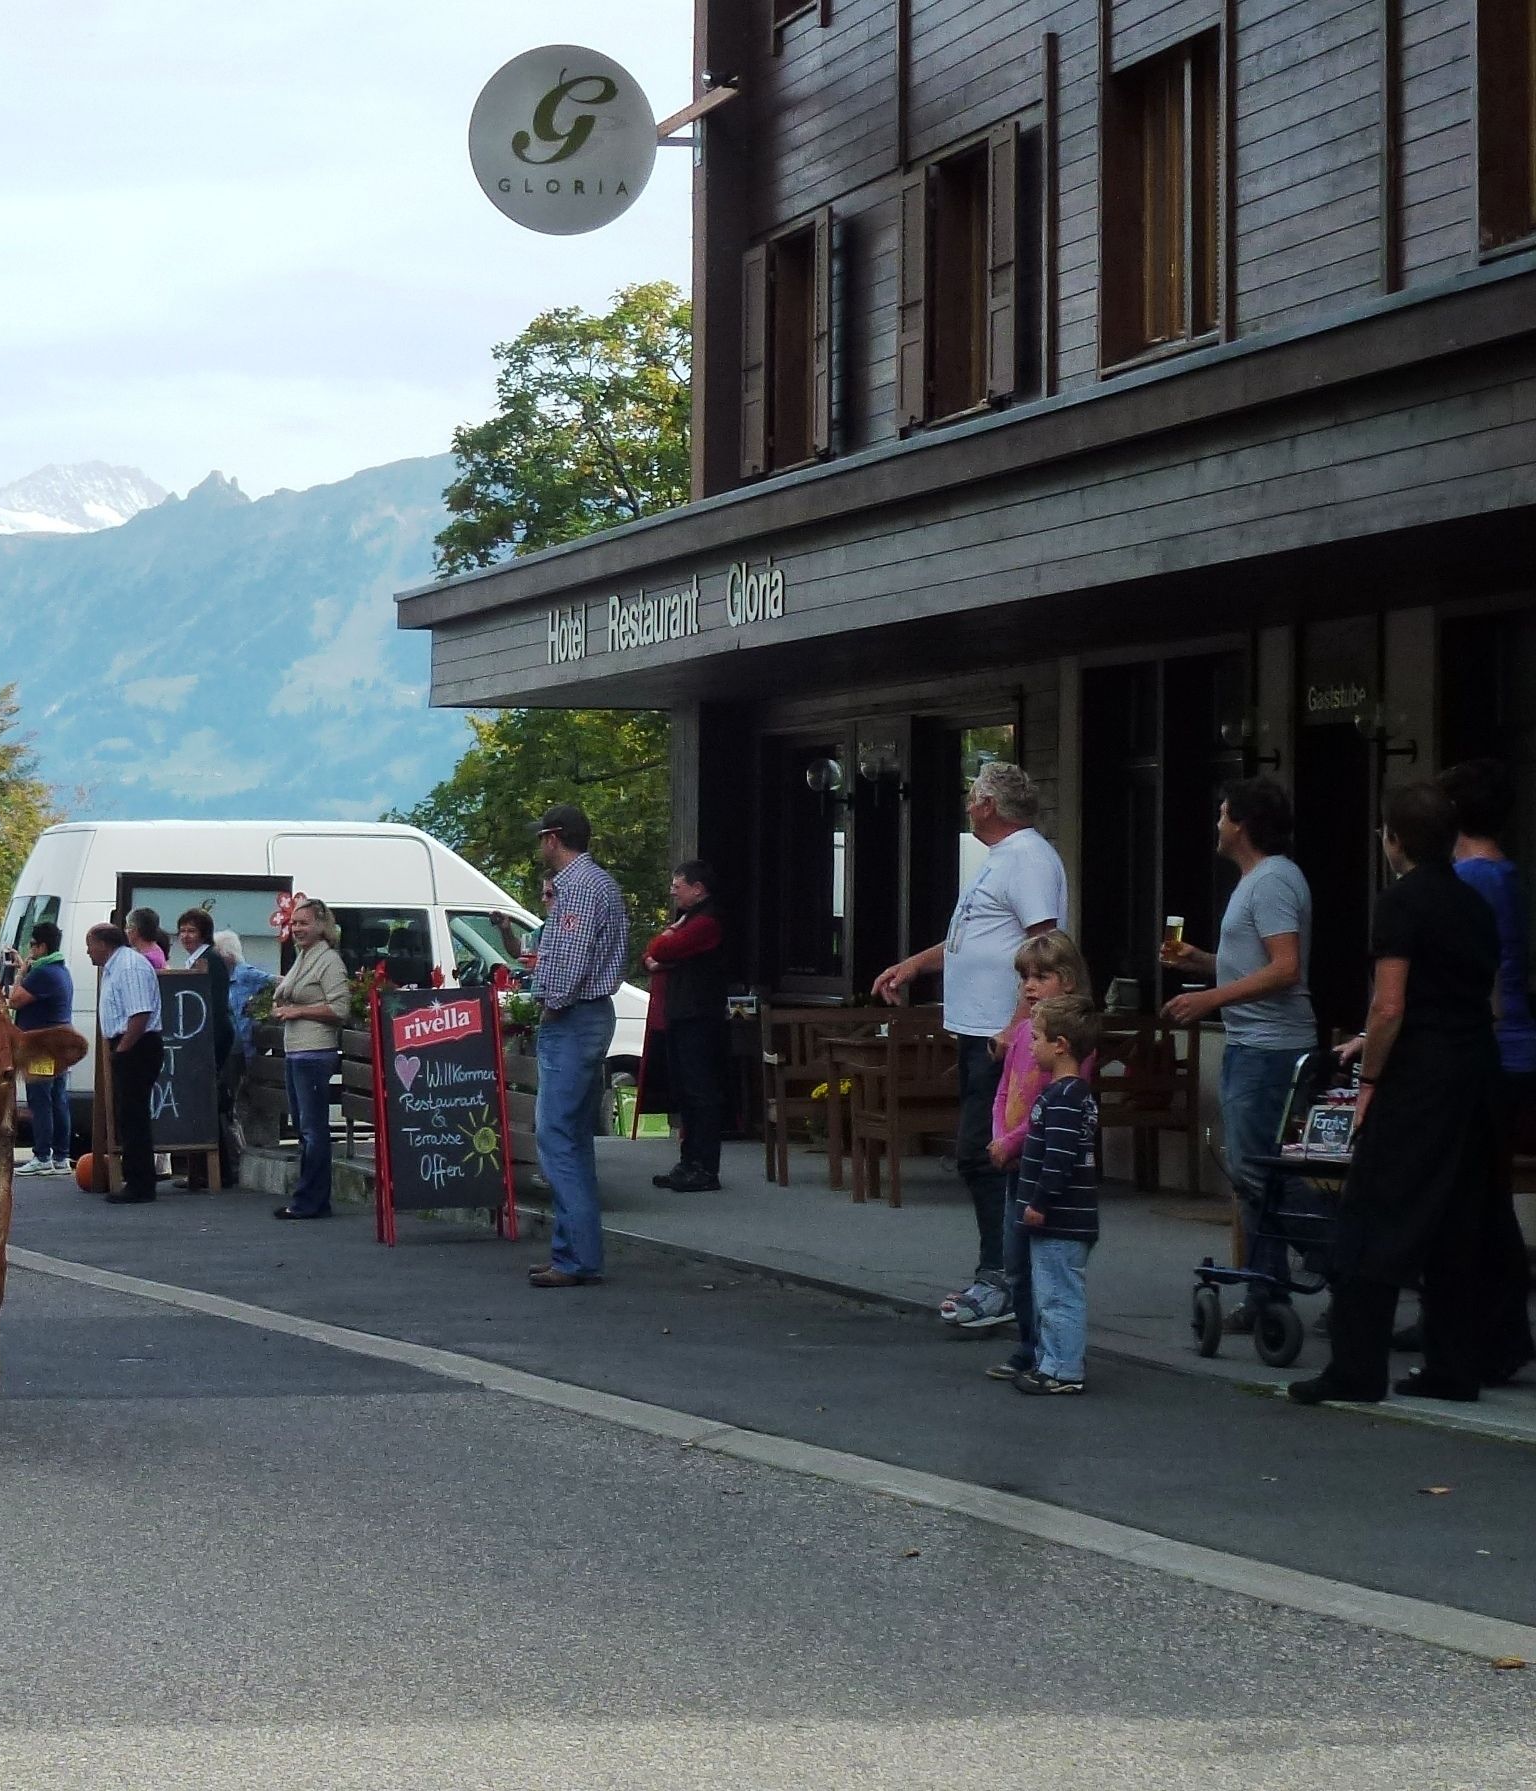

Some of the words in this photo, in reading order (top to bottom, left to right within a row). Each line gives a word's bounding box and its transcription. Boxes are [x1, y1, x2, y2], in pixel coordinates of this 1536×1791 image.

[498, 177, 630, 196] GLORIA
[547, 604, 588, 664] Hotel
[607, 573, 700, 652] Restaurant
[726, 555, 785, 628] Gloria
[1308, 682, 1366, 711] Gaststube
[404, 1008, 470, 1040] rivella
[399, 1092, 487, 1112] Restaurant
[401, 1127, 464, 1146] Terrasse
[420, 1153, 465, 1189] Offen
